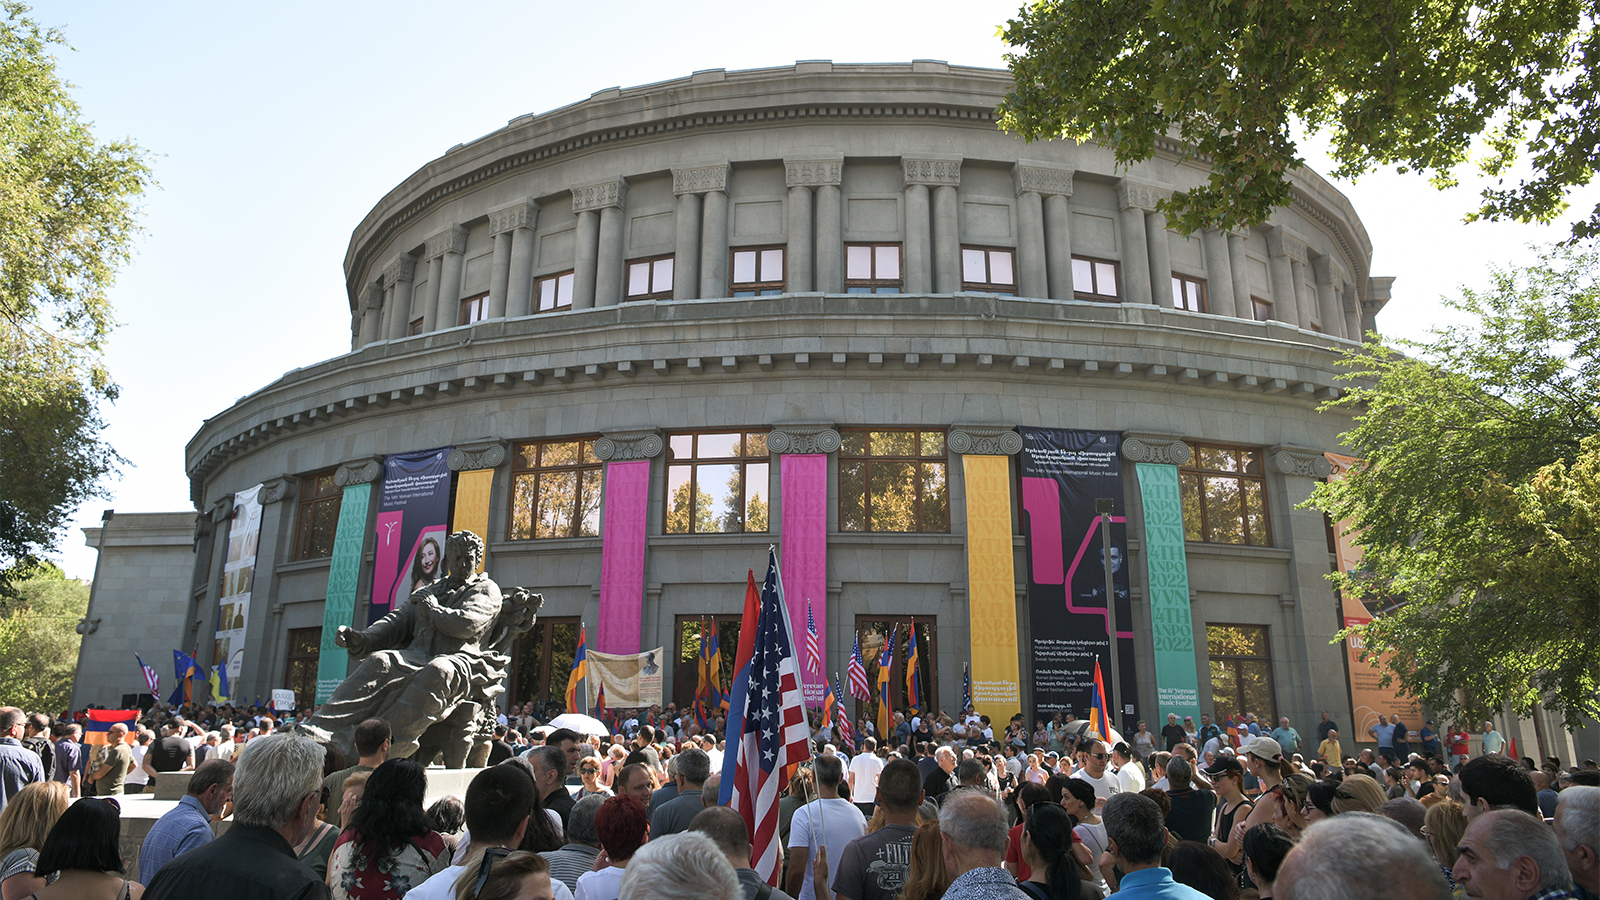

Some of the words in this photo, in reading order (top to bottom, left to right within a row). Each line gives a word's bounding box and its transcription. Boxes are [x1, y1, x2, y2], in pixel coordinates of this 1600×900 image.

[1142, 484, 1178, 500] 14TH
[968, 504, 1009, 518] 2022
[1145, 511, 1180, 526] 2022
[1148, 544, 1184, 560] 14TH
[970, 566, 1013, 582] 2022
[1150, 572, 1186, 588] 2022
[1152, 607, 1189, 624] 14TH
[972, 631, 1016, 647] 2022
[1154, 636, 1192, 652] 2022
[886, 843, 912, 864] FILT
